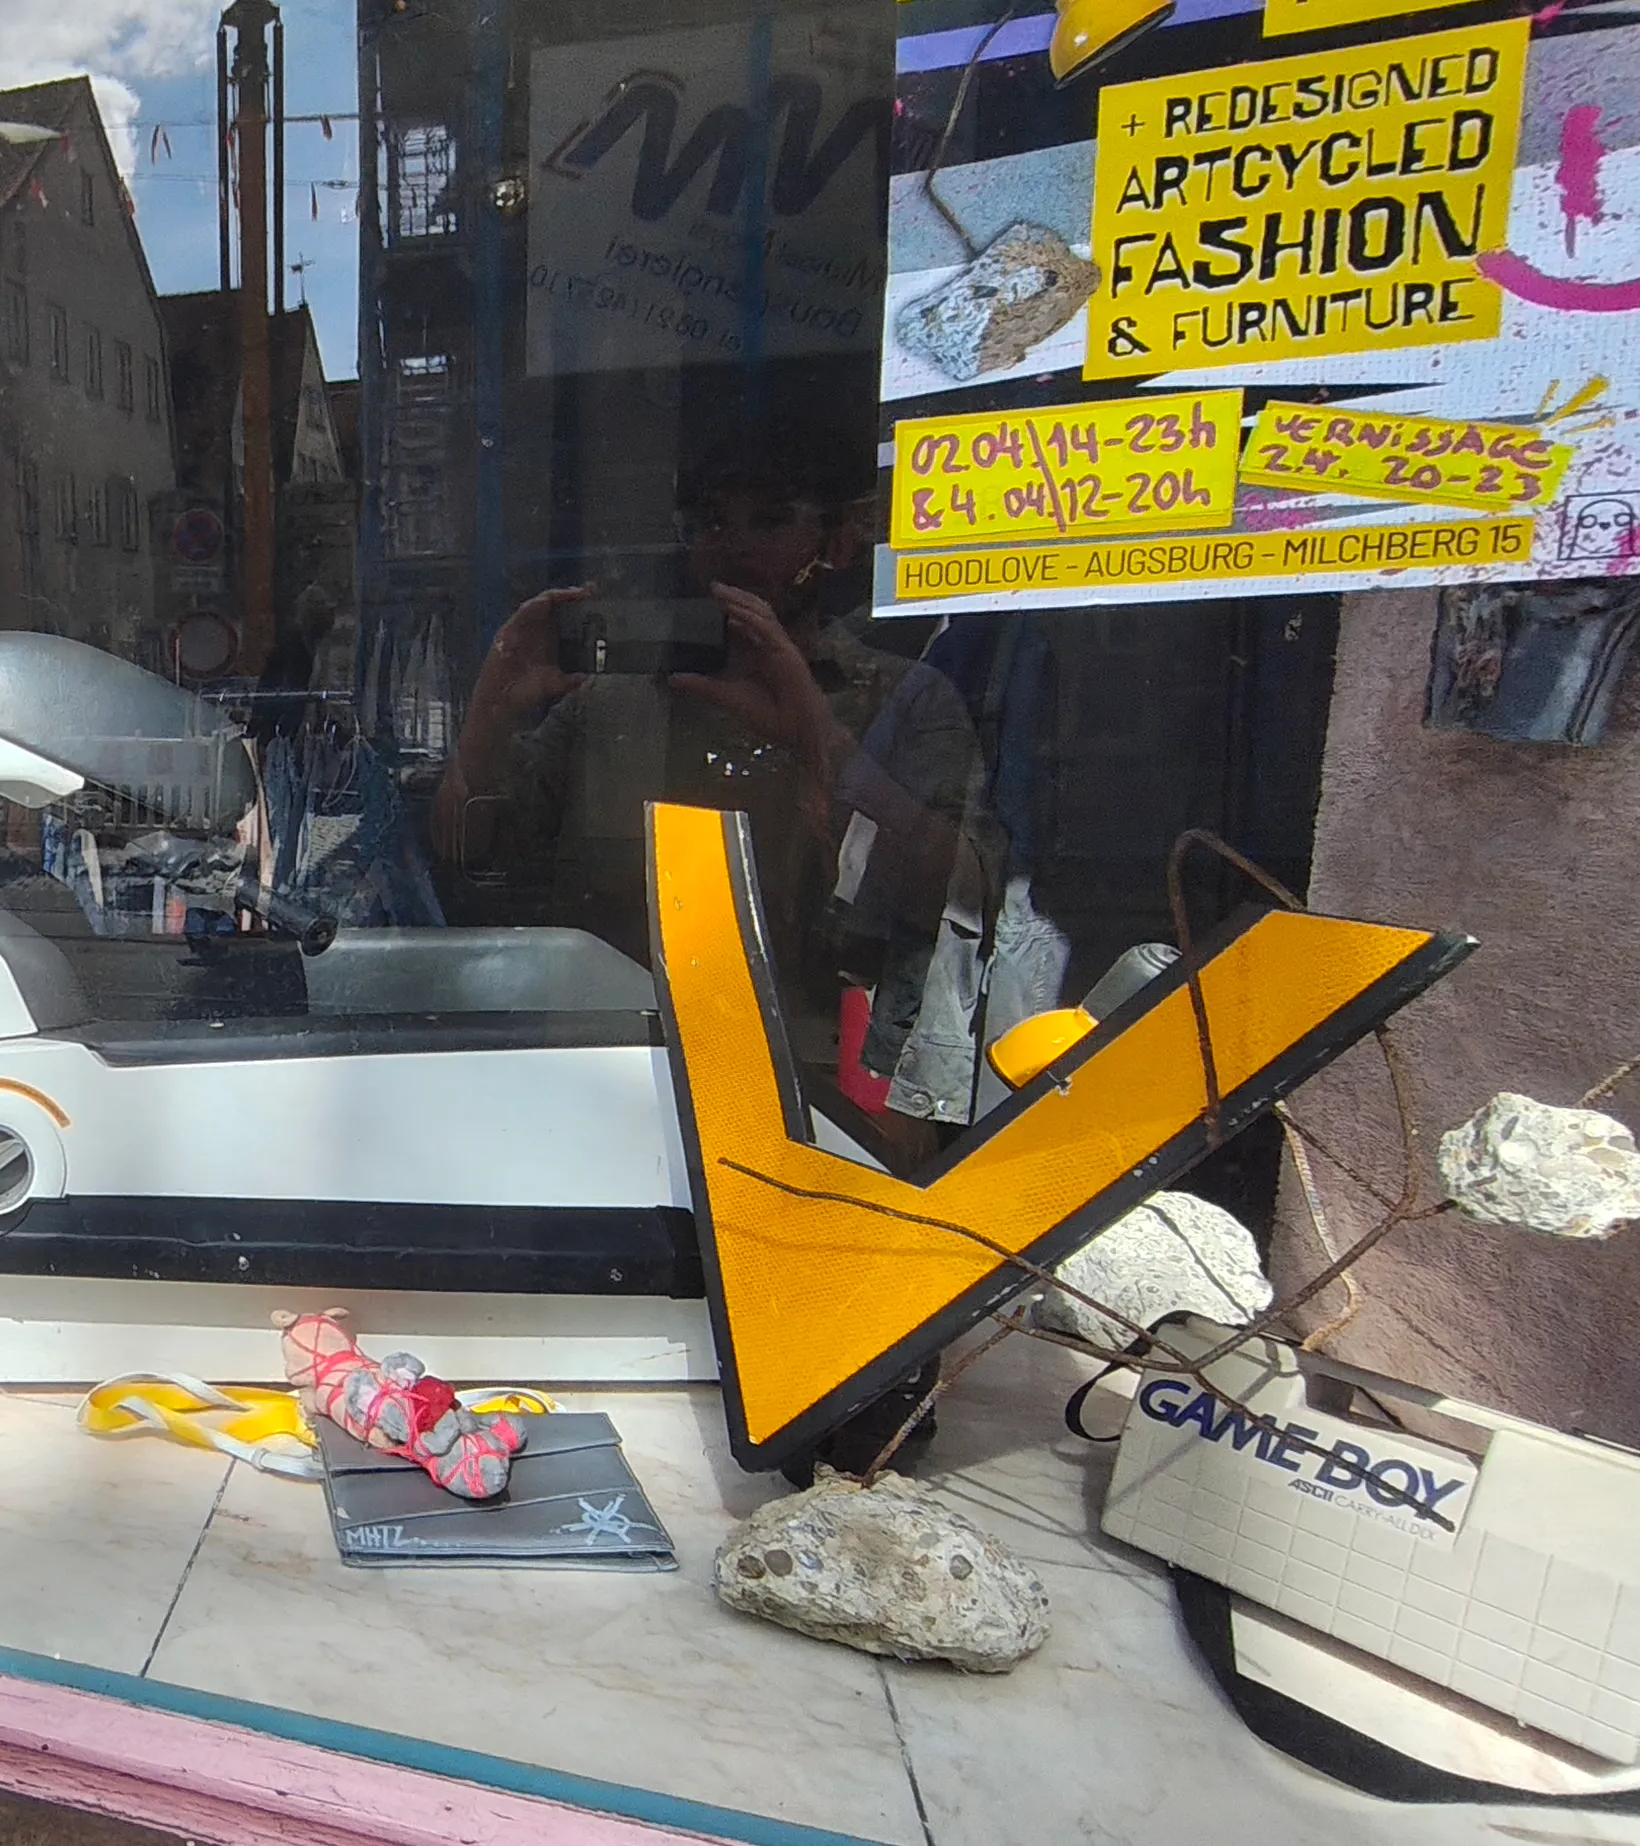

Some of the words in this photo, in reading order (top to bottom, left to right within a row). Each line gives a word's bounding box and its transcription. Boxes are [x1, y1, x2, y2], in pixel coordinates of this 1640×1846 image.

[1163, 46, 1498, 140] REDESIGNED
[1116, 110, 1493, 214] ARTCYCLED
[1110, 184, 1485, 299] FASHION
[1107, 316, 1151, 360] &
[1172, 277, 1476, 353] FURNITURE
[905, 552, 1060, 589] HOODLOVE
[1083, 531, 1254, 580] AUGSBURG
[1283, 525, 1481, 567] MILCHBERG
[1490, 523, 1523, 555] 15
[1138, 1379, 1319, 1471] GAME
[1314, 1437, 1466, 1520] BOY
[1288, 1478, 1334, 1503] ASCII
